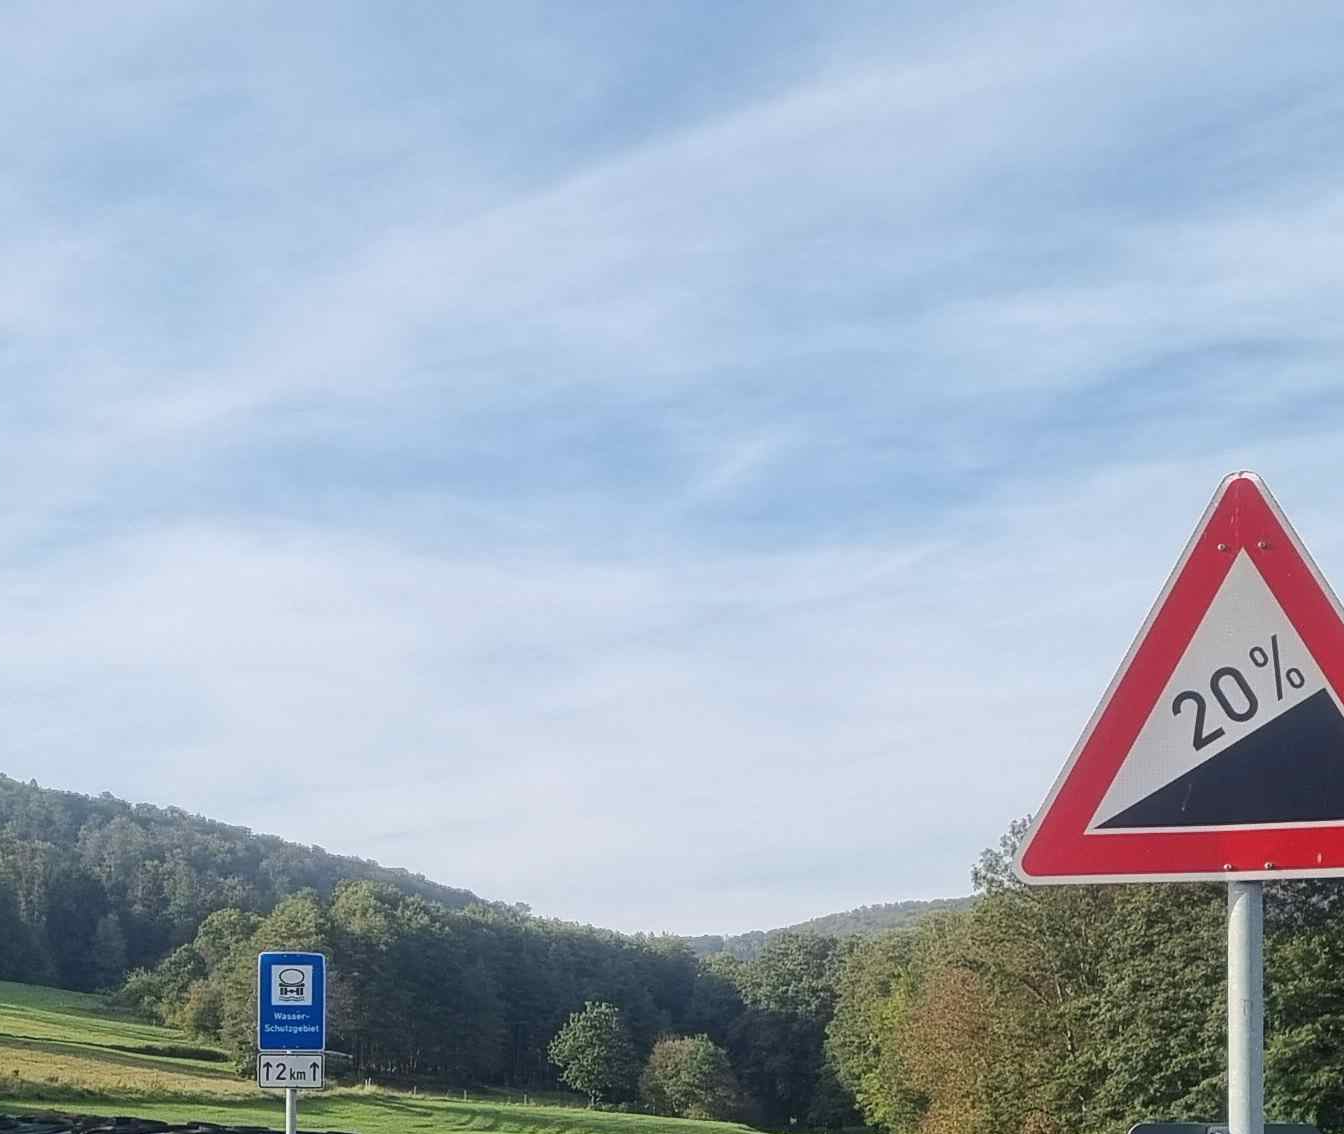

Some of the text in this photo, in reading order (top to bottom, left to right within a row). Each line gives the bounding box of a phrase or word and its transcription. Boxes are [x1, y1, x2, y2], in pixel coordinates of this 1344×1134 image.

[1171, 634, 1305, 751] 20%
[274, 1012, 310, 1020] Wasser-
[276, 1063, 306, 1080] 2 km
